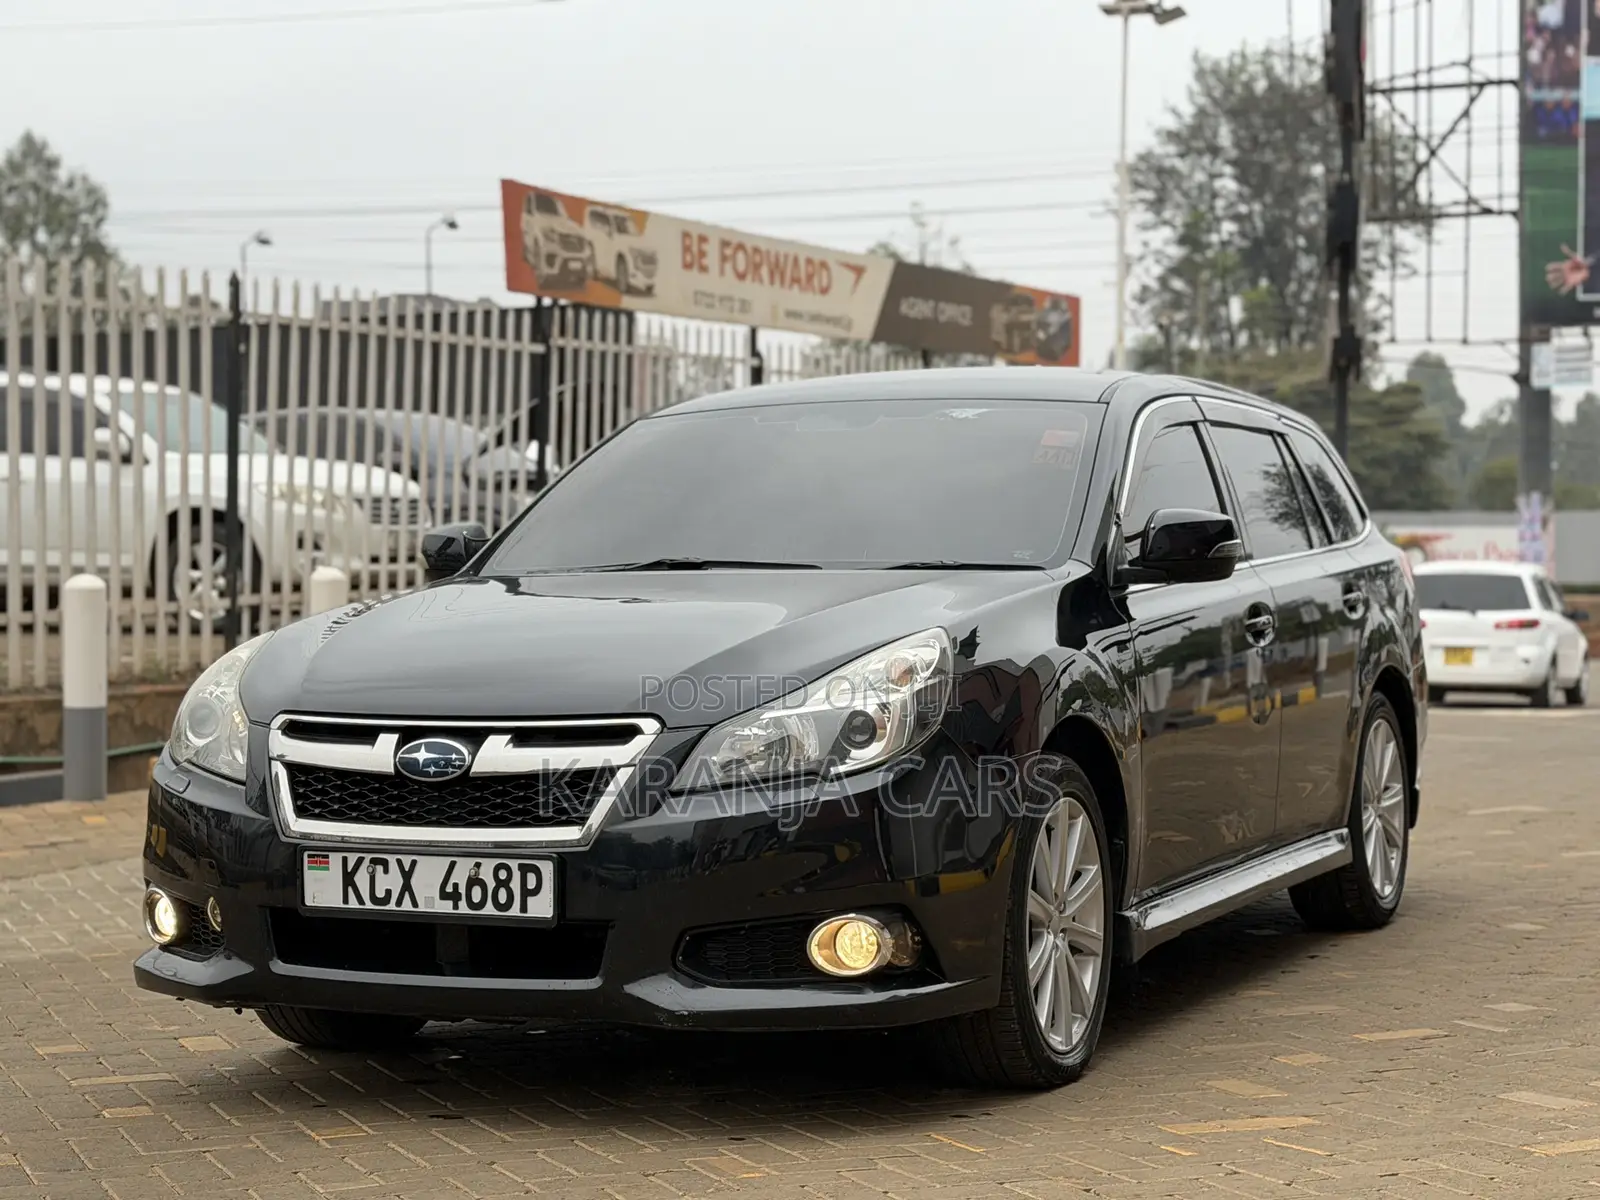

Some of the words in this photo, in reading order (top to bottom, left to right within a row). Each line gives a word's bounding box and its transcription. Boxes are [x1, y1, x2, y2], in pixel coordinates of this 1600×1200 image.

[681, 230, 710, 274] BE
[719, 237, 833, 297] FORWARD
[341, 855, 419, 909] KCX
[438, 859, 543, 914] 468P
